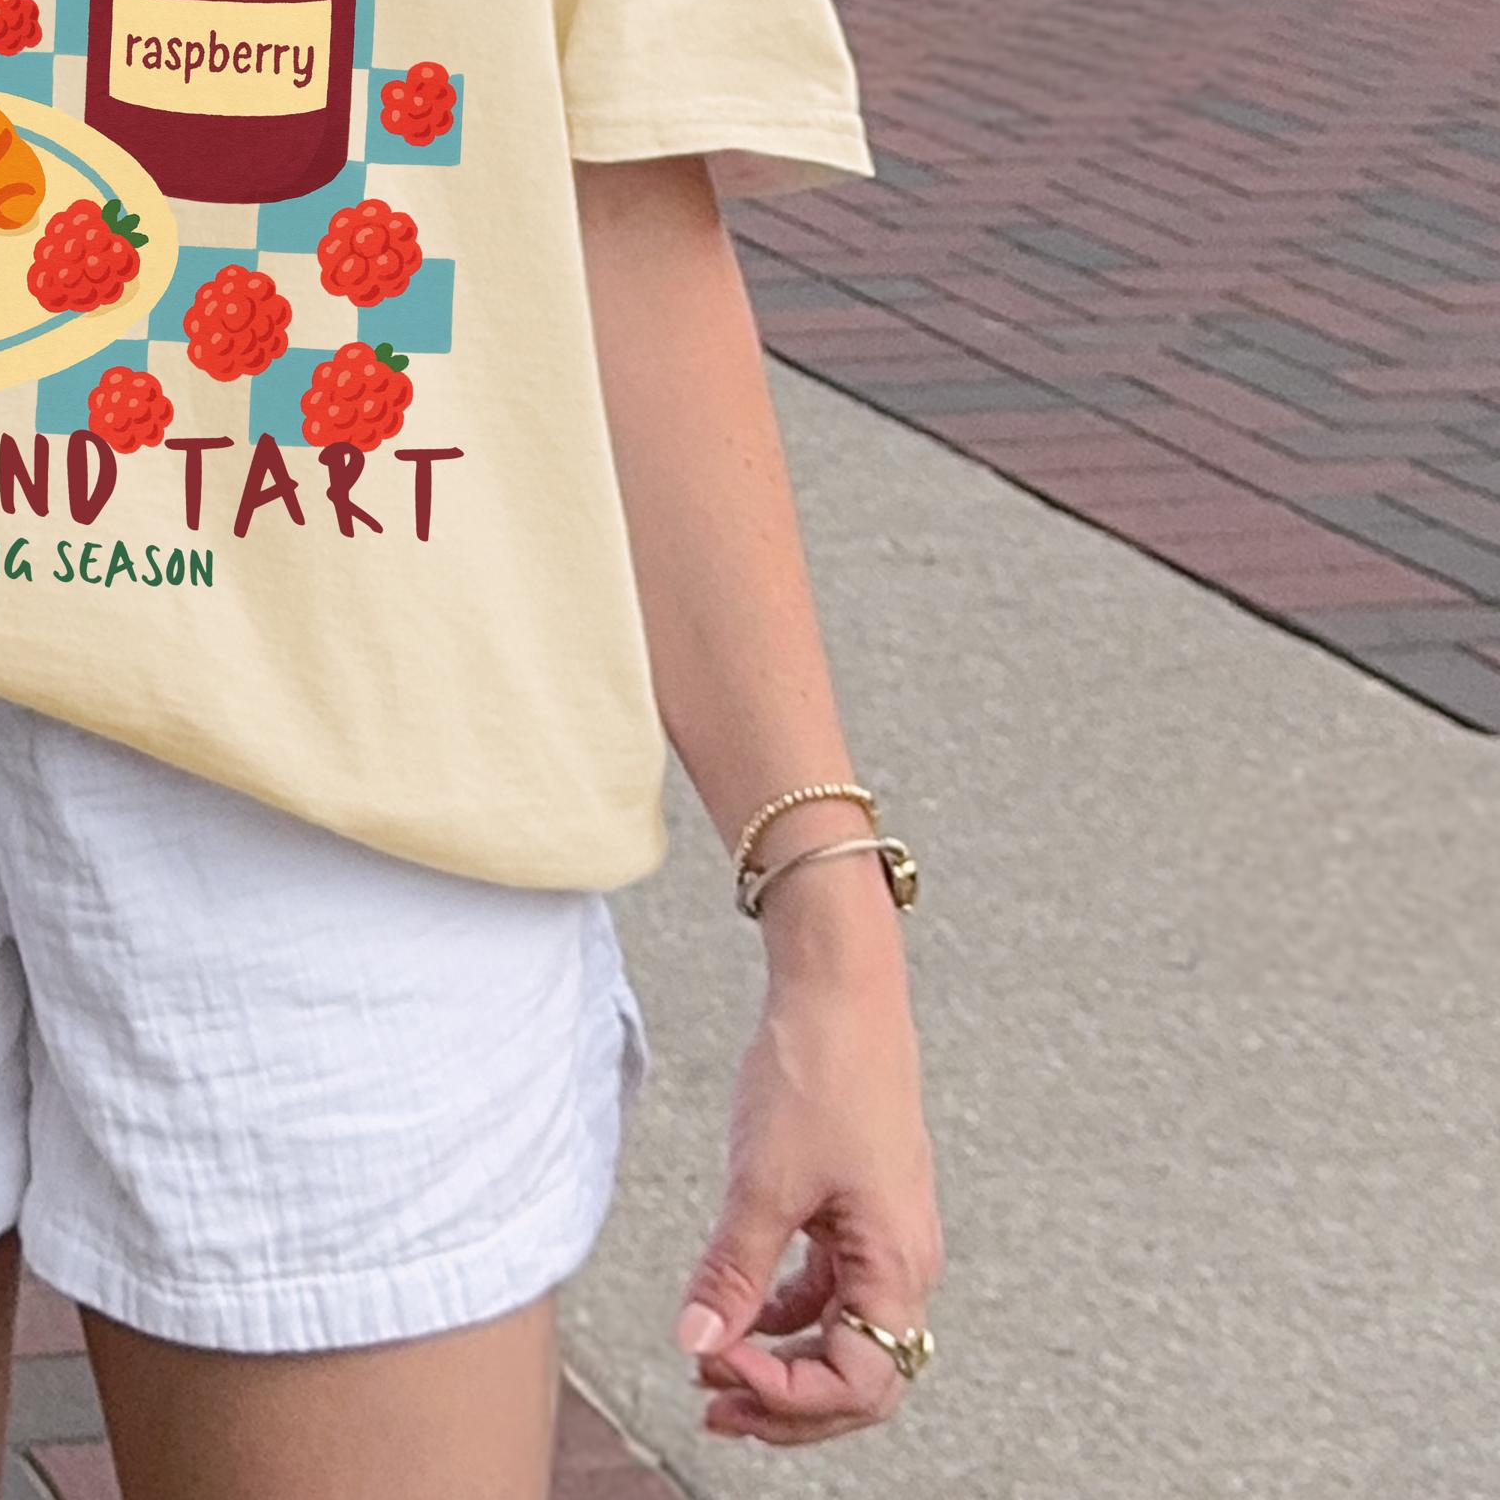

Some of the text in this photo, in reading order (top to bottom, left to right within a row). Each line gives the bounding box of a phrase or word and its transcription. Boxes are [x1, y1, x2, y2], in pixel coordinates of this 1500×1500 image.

[125, 29, 315, 89] raspberry
[164, 434, 464, 542] TART
[53, 541, 214, 587] SEASON
